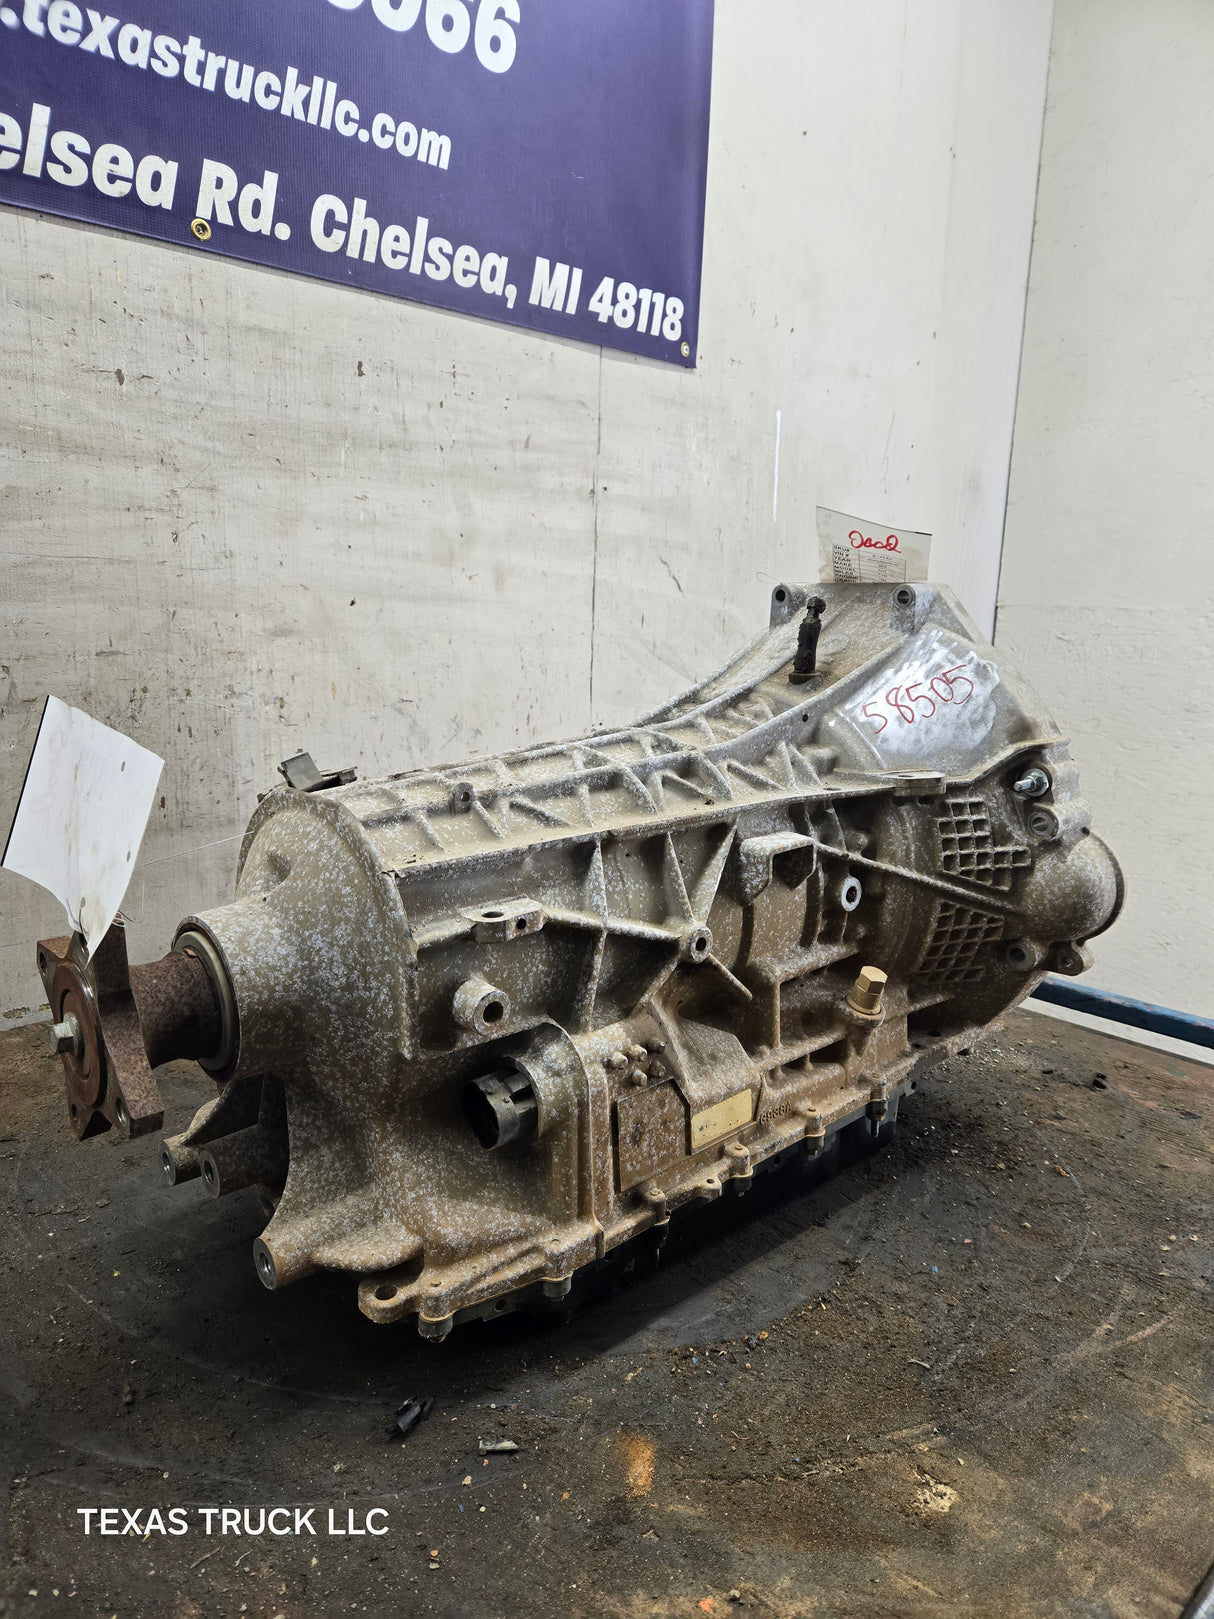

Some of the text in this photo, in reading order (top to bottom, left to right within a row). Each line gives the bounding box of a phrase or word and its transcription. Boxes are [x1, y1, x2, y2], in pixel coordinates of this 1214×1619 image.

[196, 159, 290, 240] Rd.
[311, 194, 517, 309] Chelsea,
[529, 256, 582, 314] MI
[589, 277, 684, 341] 48118
[863, 665, 973, 734] 58505
